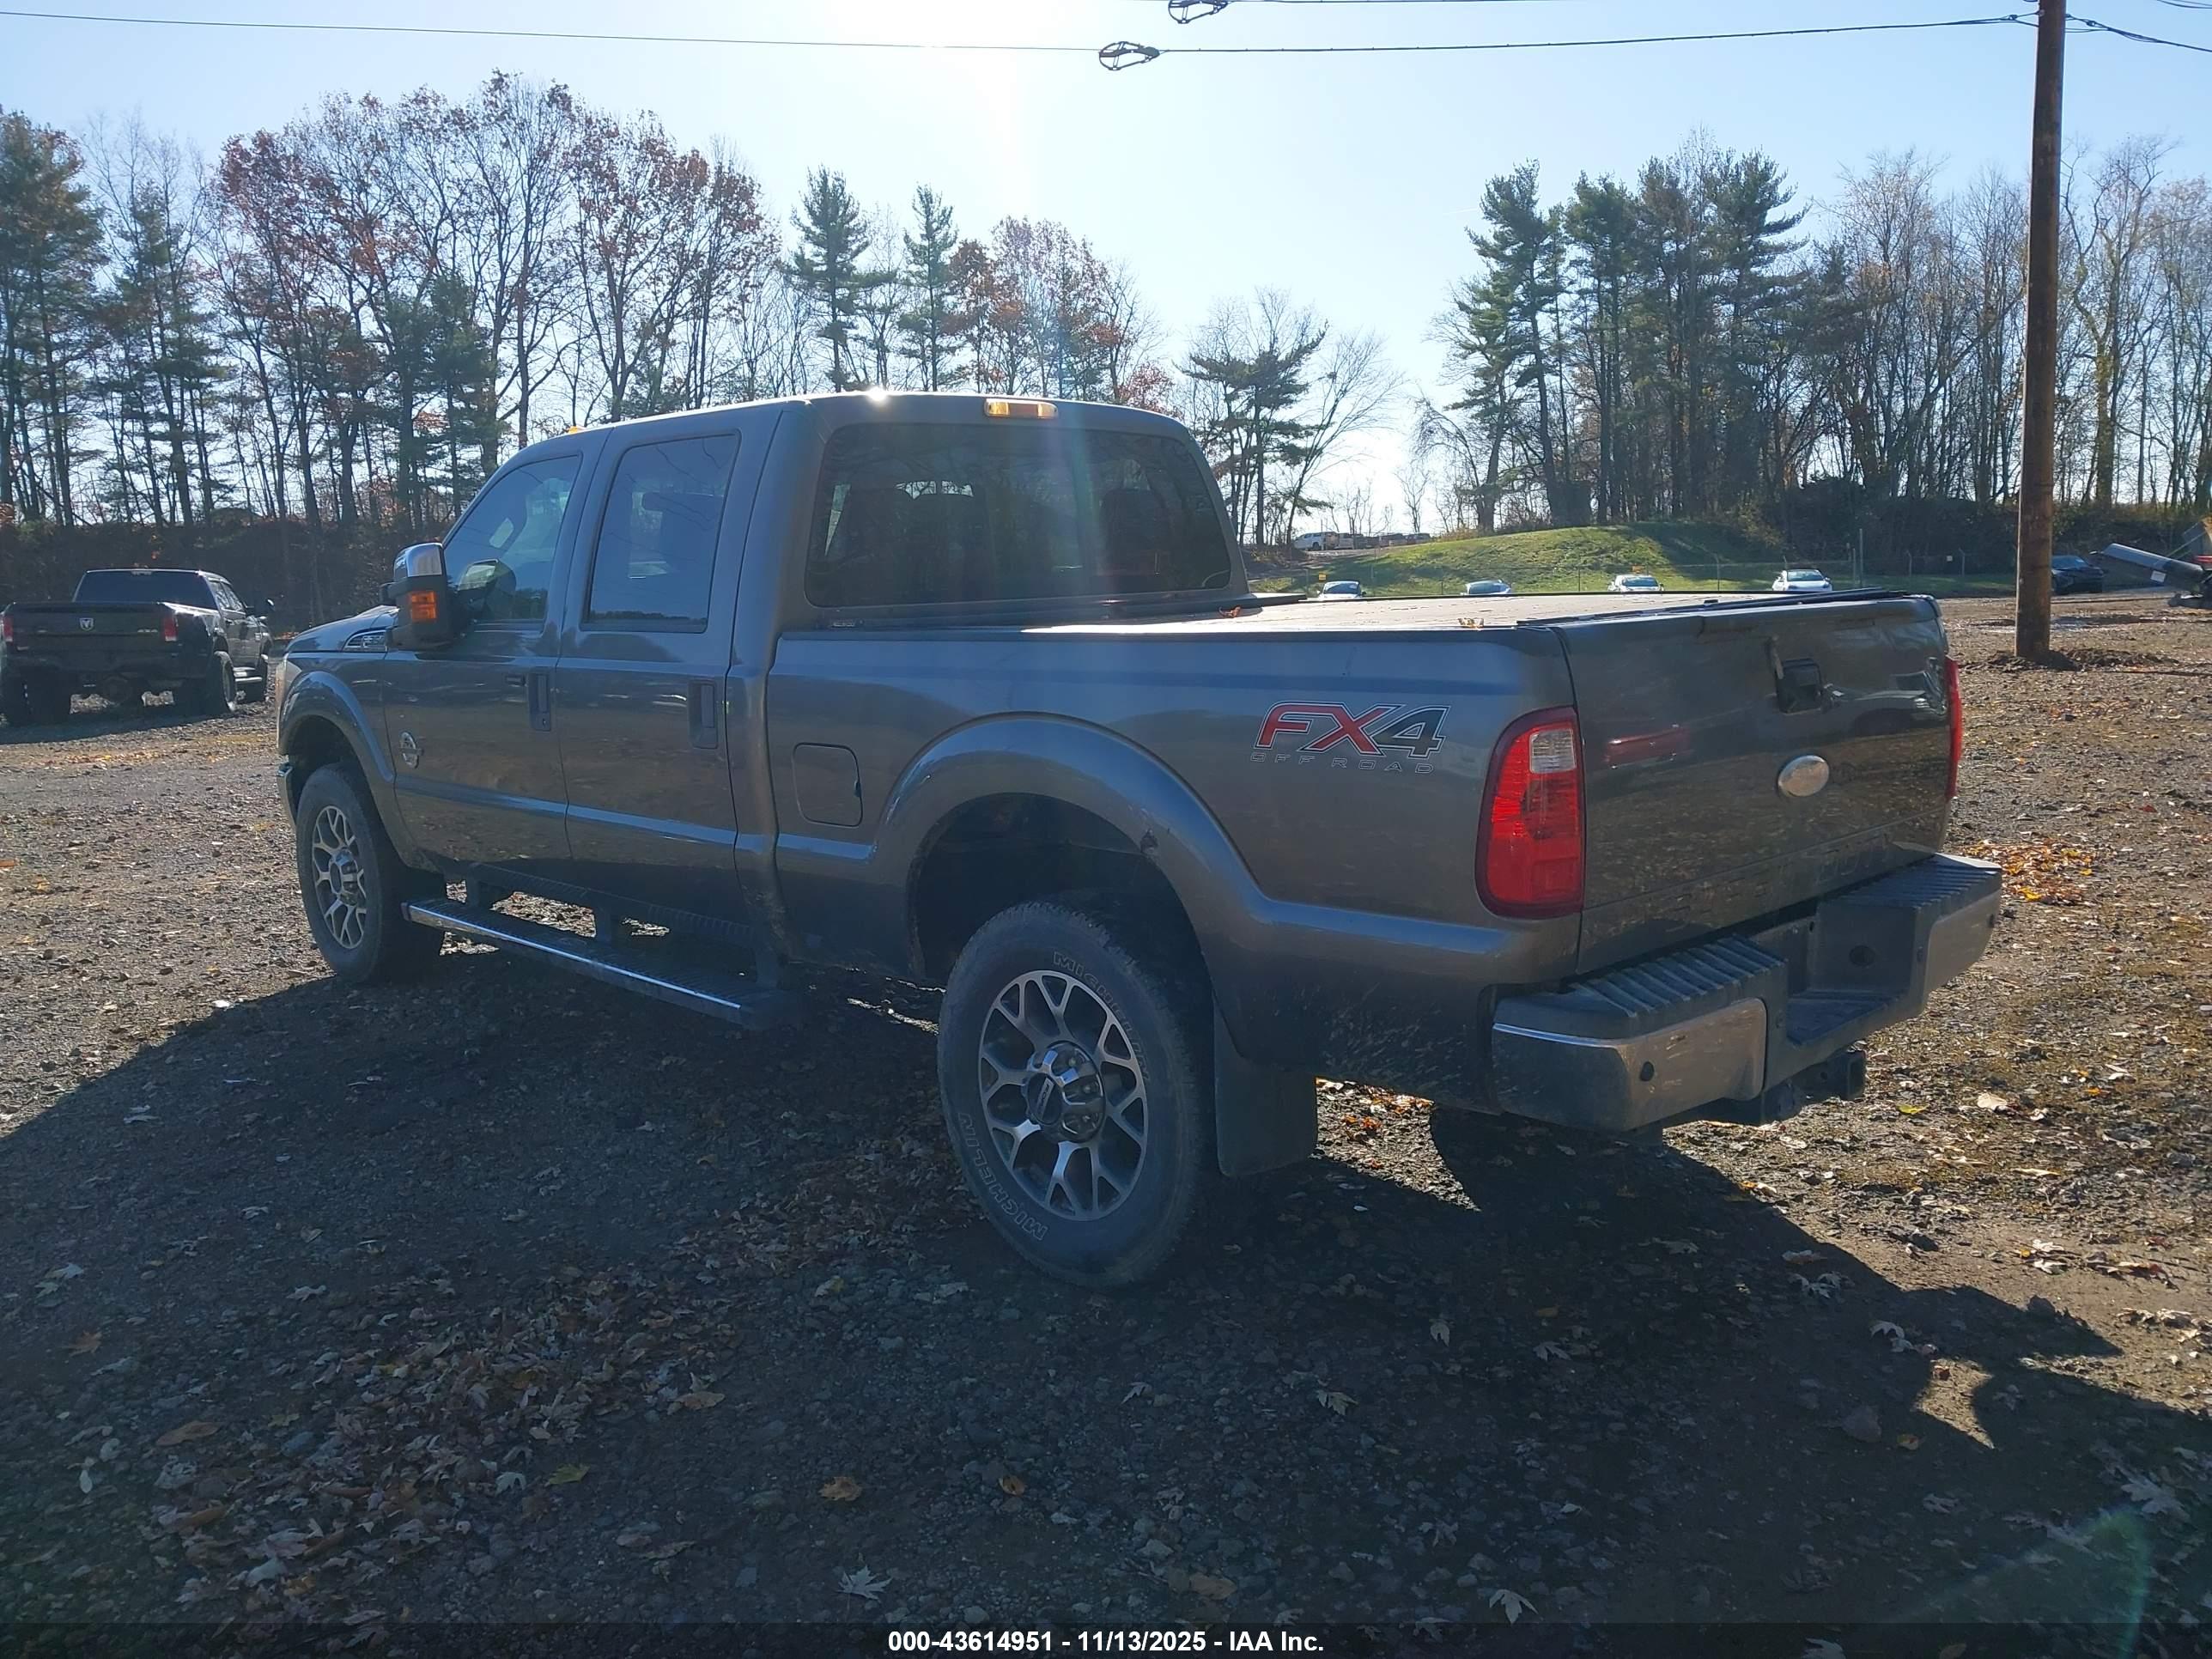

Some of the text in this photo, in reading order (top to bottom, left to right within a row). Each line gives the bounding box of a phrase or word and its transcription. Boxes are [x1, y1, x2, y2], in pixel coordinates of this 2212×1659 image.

[1250, 753, 1434, 775] OFF ROAD
[1254, 701, 1450, 759] FX4
[1053, 951, 1149, 1082] MICHELIN
[959, 1113, 1048, 1241] MICHELIN
